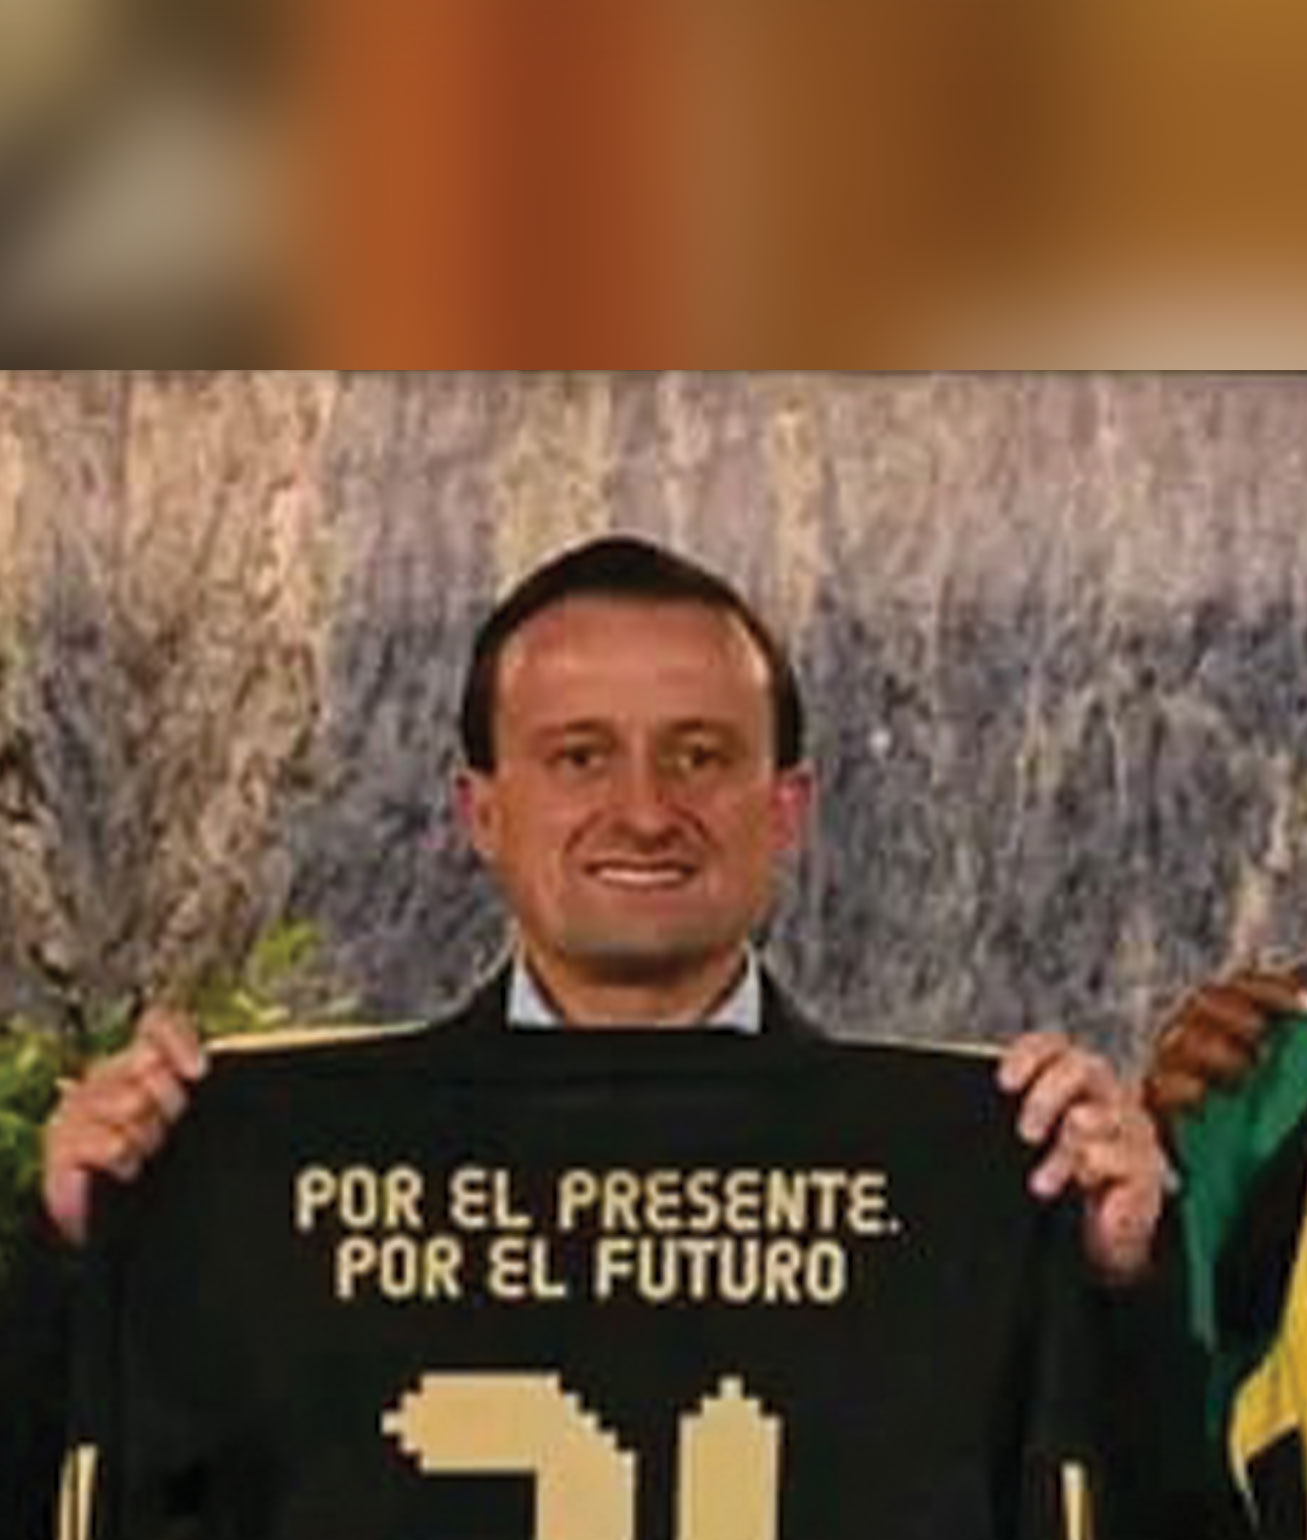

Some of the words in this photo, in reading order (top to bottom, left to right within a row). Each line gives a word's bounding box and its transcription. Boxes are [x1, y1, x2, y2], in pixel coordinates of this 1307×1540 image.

[298, 1167, 422, 1230] POR
[451, 1168, 530, 1230] EL
[560, 1170, 900, 1234] PRESENTE.
[337, 1239, 460, 1300] POR
[490, 1239, 565, 1300] EL
[597, 1240, 845, 1300] FUTURO
